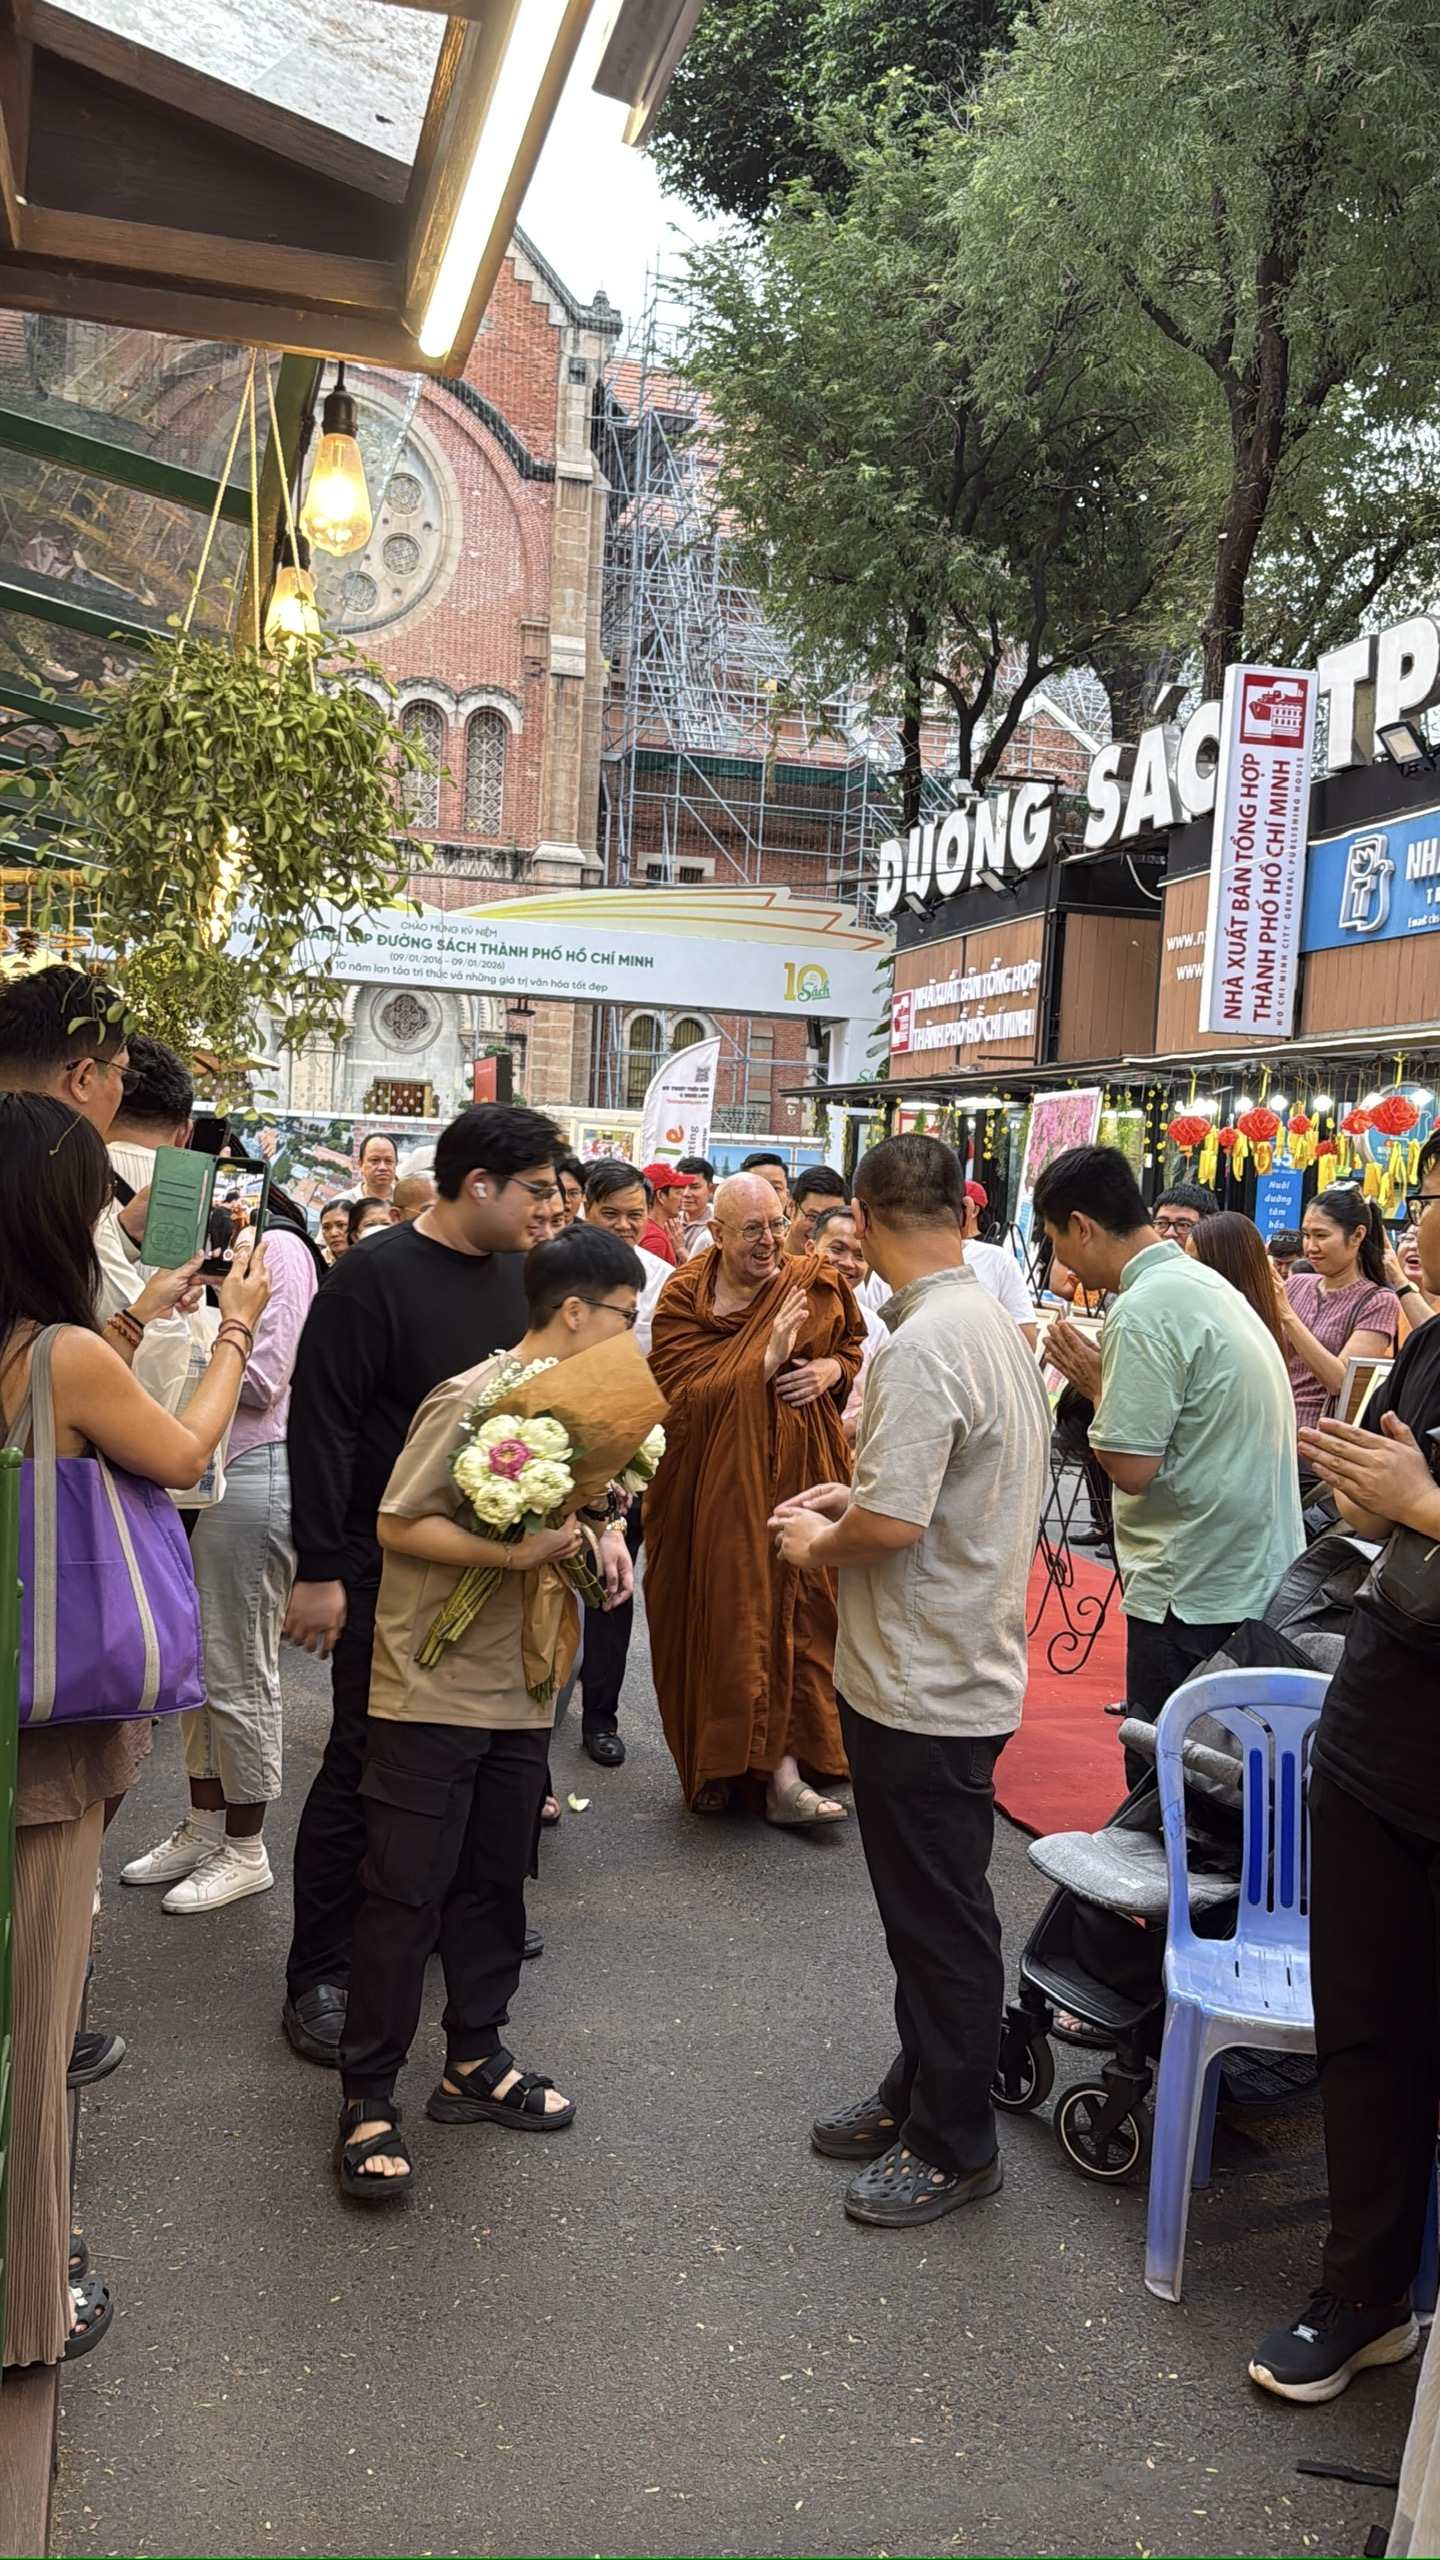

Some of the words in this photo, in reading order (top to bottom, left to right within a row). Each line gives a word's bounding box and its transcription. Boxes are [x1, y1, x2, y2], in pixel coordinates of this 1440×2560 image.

[1240, 753, 1265, 798] HỢP
[1269, 760, 1290, 817] MINH
[1294, 757, 1304, 792] HOUSE
[875, 777, 1051, 916] ĐƯỜNG
[1230, 804, 1257, 863] TỔNG
[1264, 820, 1286, 857] CHÍ
[1289, 799, 1301, 865] PUBLISHING
[1227, 867, 1252, 911] BẢN
[1259, 863, 1282, 894] HỒ
[1284, 871, 1294, 919] GENERAL
[401, 920, 428, 932] CHÀO
[430, 922, 458, 934] MỪNG
[475, 927, 498, 938] NIỆM
[1256, 899, 1279, 943] PHỐ
[1282, 925, 1290, 949] CITY
[232, 921, 247, 934] 10
[377, 933, 433, 950] ĐƯỜNG
[436, 937, 477, 954] SÁCH
[480, 941, 529, 958] THÀNH
[532, 945, 562, 961] PHỐ
[565, 947, 588, 963] HỒ
[590, 951, 616, 966] CHÍ
[618, 954, 654, 968] MINH
[1166, 930, 1206, 951] www.n
[1224, 916, 1248, 970] XUẤT
[335, 960, 347, 970] 10
[348, 961, 371, 972] năm
[373, 964, 390, 974] lan
[425, 968, 449, 979] thức
[465, 972, 497, 985] những
[499, 974, 515, 987] giá
[517, 976, 528, 988] trị
[530, 977, 549, 988] văn
[550, 979, 570, 989] hóa
[572, 980, 587, 990] tốt
[588, 981, 608, 993] đẹp
[390, 952, 443, 965] (09/01/2016
[451, 957, 505, 971] 09/01/2026)
[1279, 955, 1288, 982] MINH
[797, 979, 831, 1002] Sách
[1222, 976, 1244, 1019] NHÀ
[1251, 949, 1276, 1023] THÀNH
[1278, 988, 1286, 1006] CHI
[1003, 1009, 1035, 1038] MINH
[1277, 1011, 1284, 1026] HO
